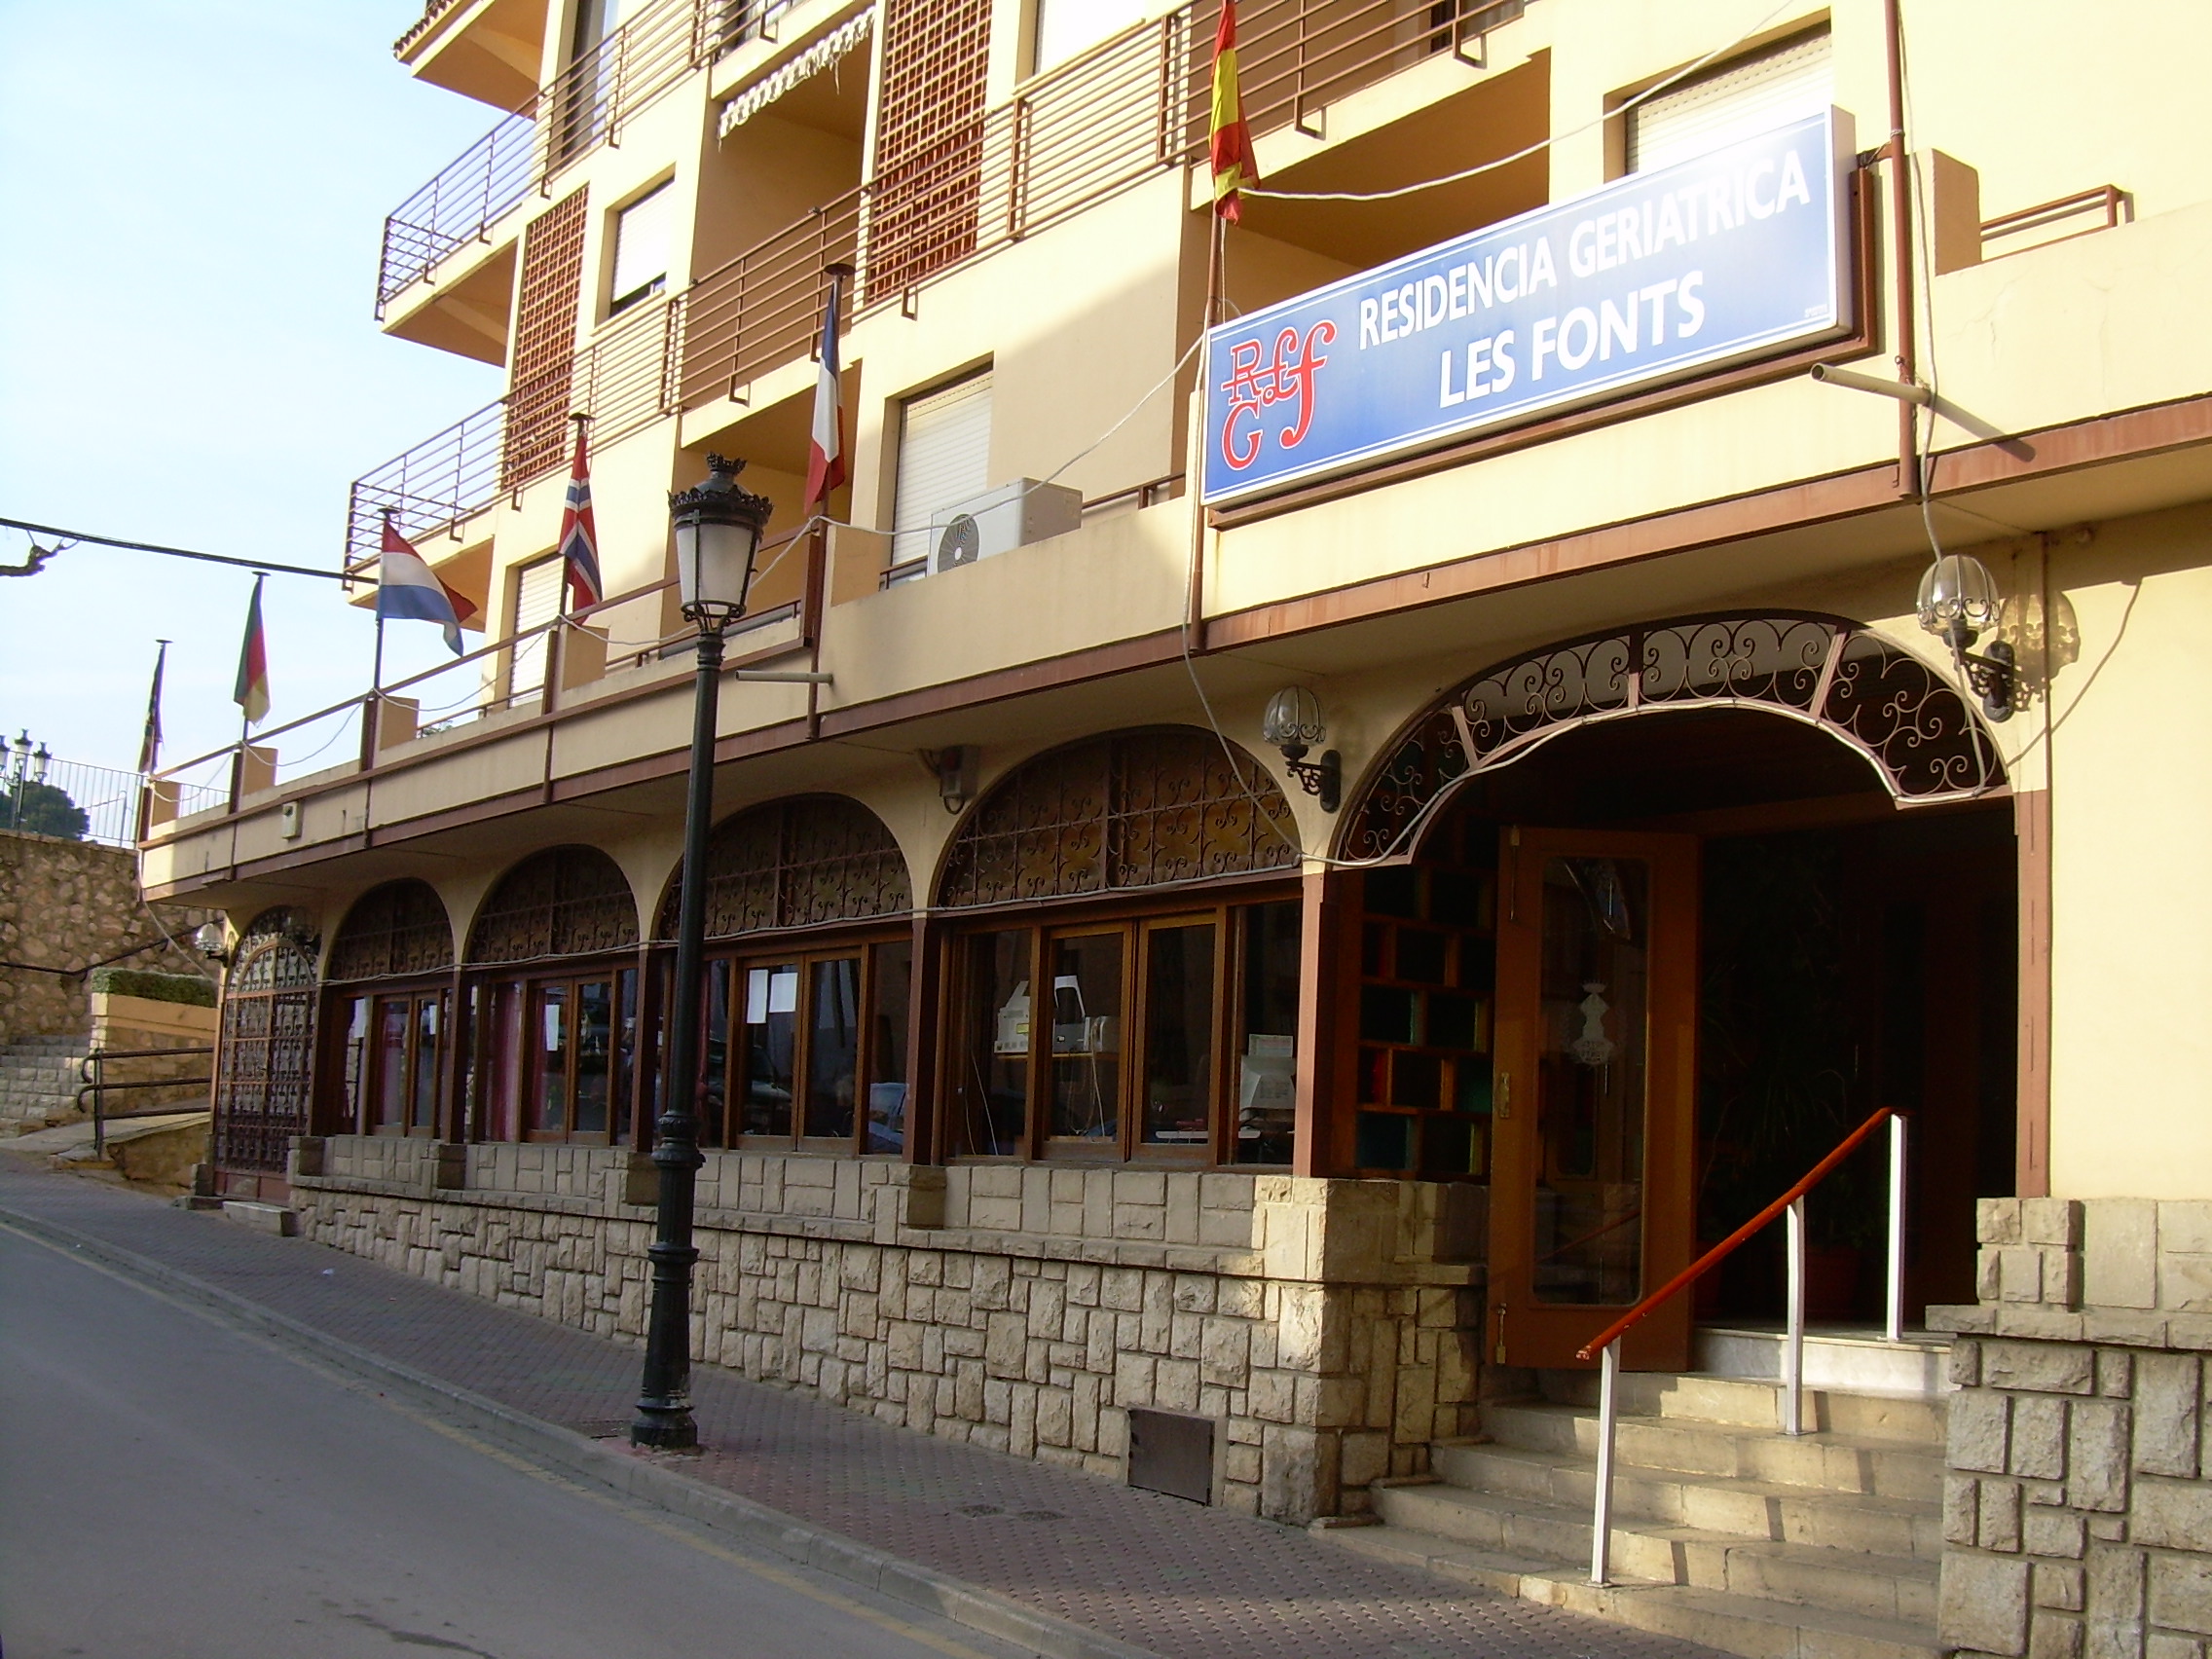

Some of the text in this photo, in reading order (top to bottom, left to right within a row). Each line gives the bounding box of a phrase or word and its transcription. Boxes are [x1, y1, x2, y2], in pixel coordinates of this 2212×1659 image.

[1359, 149, 1811, 350] RESIDENCIA GERIATRICA
[1439, 270, 1705, 409] LES FONTS
